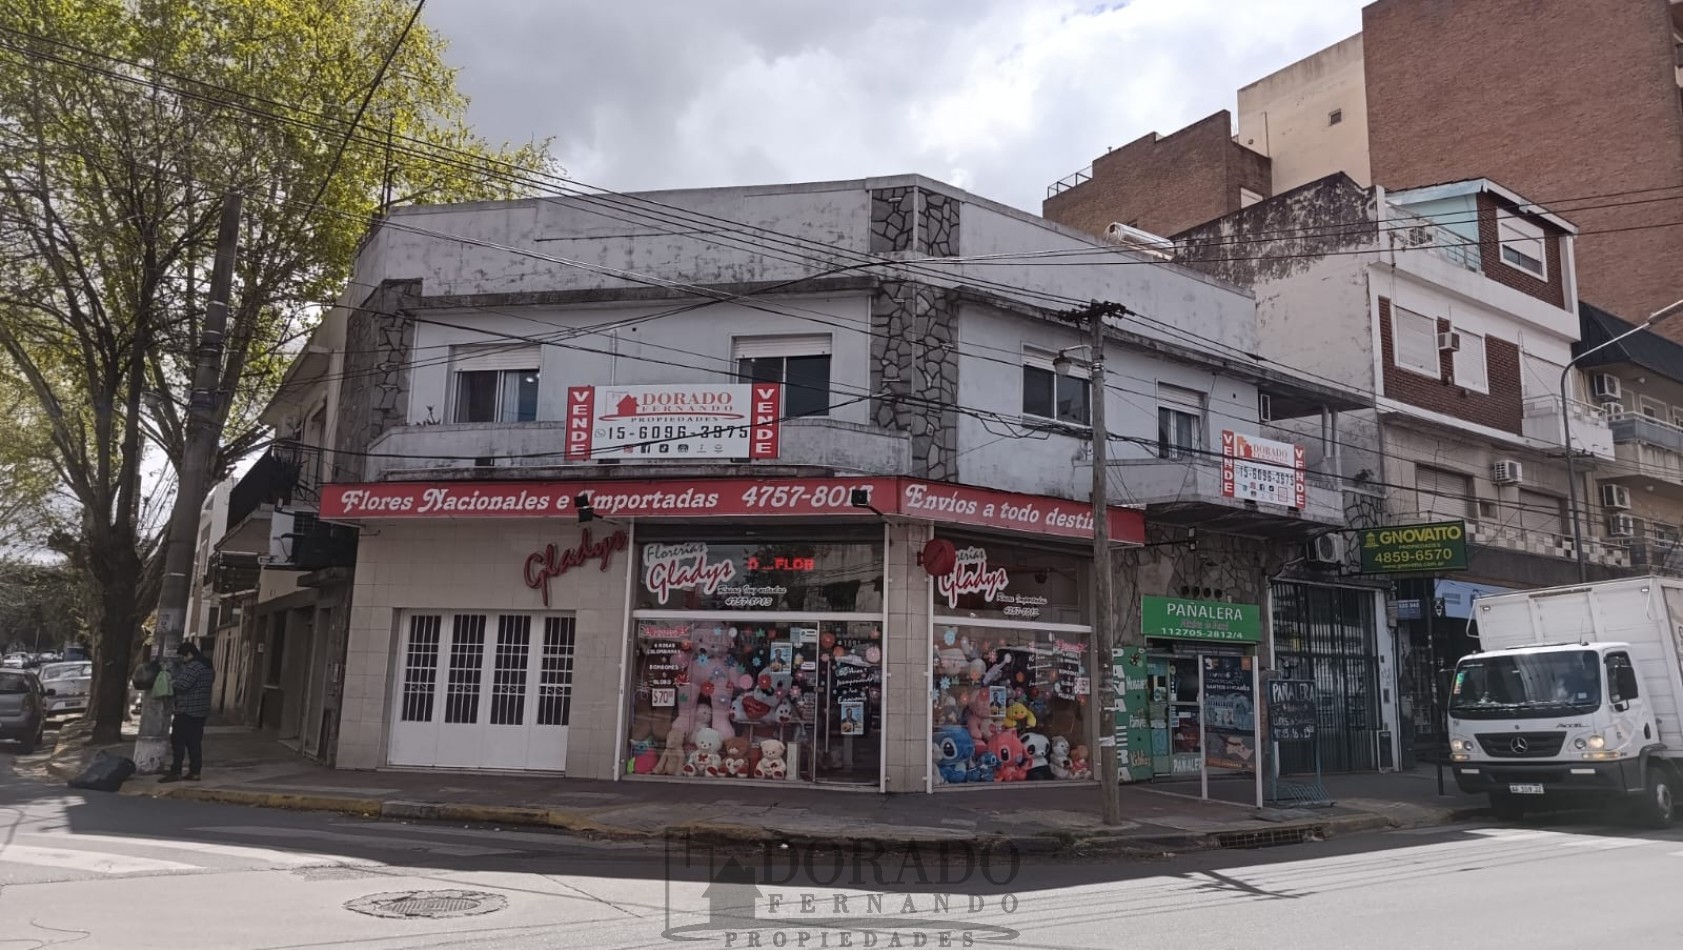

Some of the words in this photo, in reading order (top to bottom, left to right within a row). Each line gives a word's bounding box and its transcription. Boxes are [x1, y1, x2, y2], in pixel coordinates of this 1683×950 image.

[642, 392, 732, 406] DORADO
[571, 391, 589, 455] VENDE
[609, 425, 749, 440] 15-6096-3975
[755, 389, 774, 454] VENDE
[1223, 434, 1234, 493] VENDE
[1295, 448, 1304, 505] VENDE
[341, 490, 414, 513] Flores
[417, 488, 550, 513] Nacionales
[556, 496, 569, 510] e
[906, 483, 977, 515] Envíos
[983, 505, 994, 518] a
[1000, 502, 1040, 523] todo
[1375, 548, 1452, 563] 4859-6570
[1380, 526, 1461, 545] GNOVATTO
[523, 526, 627, 607] Gladys
[649, 555, 732, 601] Gladys
[942, 561, 1006, 605] Gladys
[1167, 602, 1242, 620] PAÑALERA
